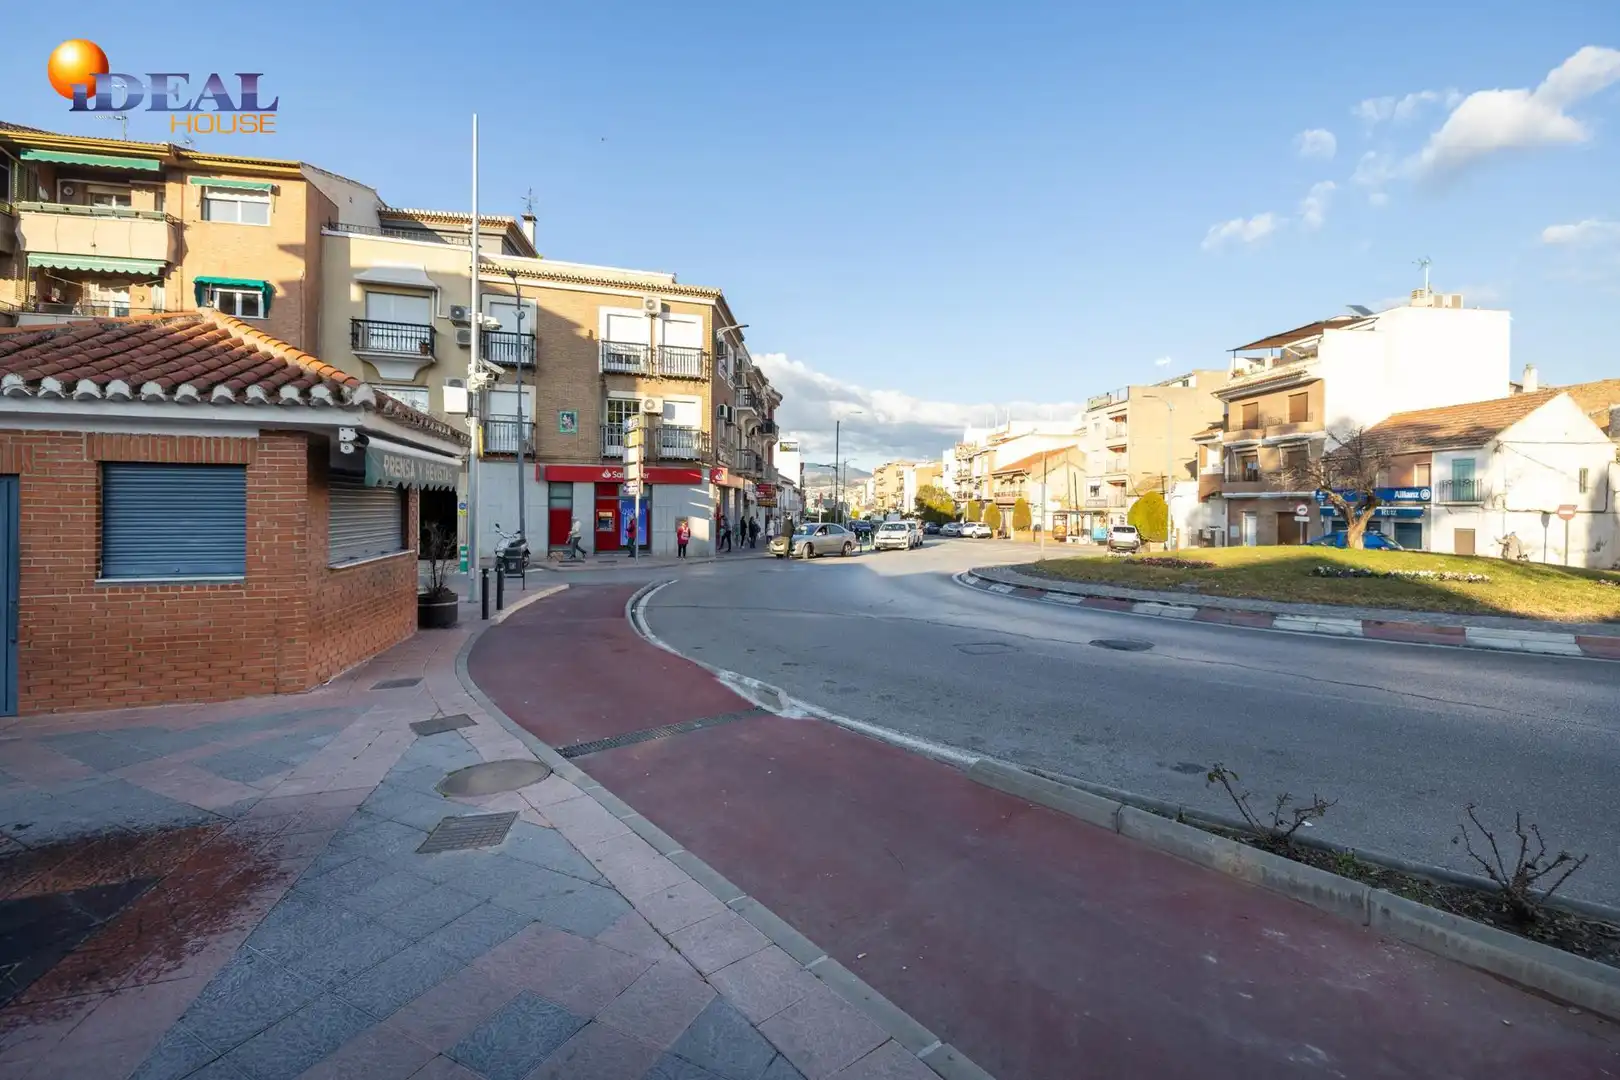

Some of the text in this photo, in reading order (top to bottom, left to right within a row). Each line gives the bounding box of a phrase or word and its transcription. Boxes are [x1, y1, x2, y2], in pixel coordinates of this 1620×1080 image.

[383, 454, 454, 482] PRENSA Y REVISTAS
[1394, 490, 1420, 499] Allianz
